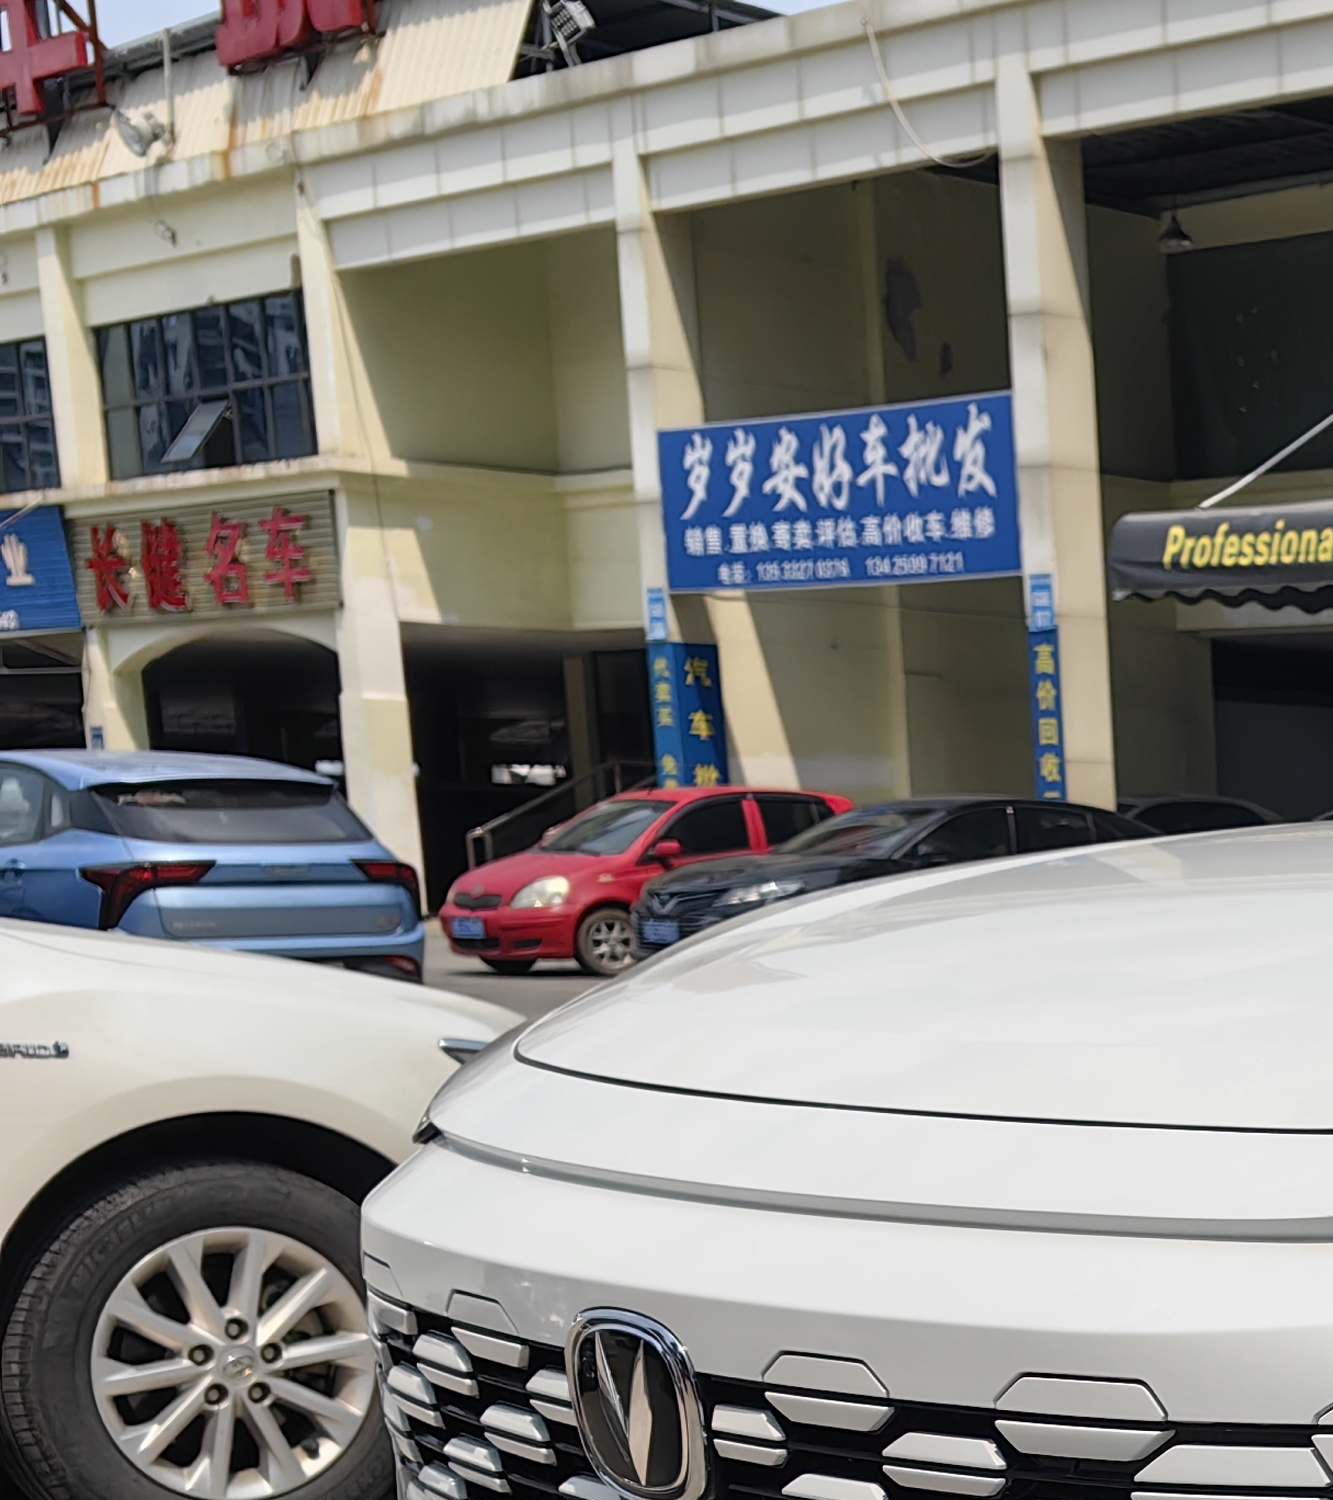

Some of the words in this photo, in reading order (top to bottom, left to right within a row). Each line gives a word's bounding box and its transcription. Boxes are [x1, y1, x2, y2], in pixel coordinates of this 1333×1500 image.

[681, 402, 998, 520] 岁岁安好车批发
